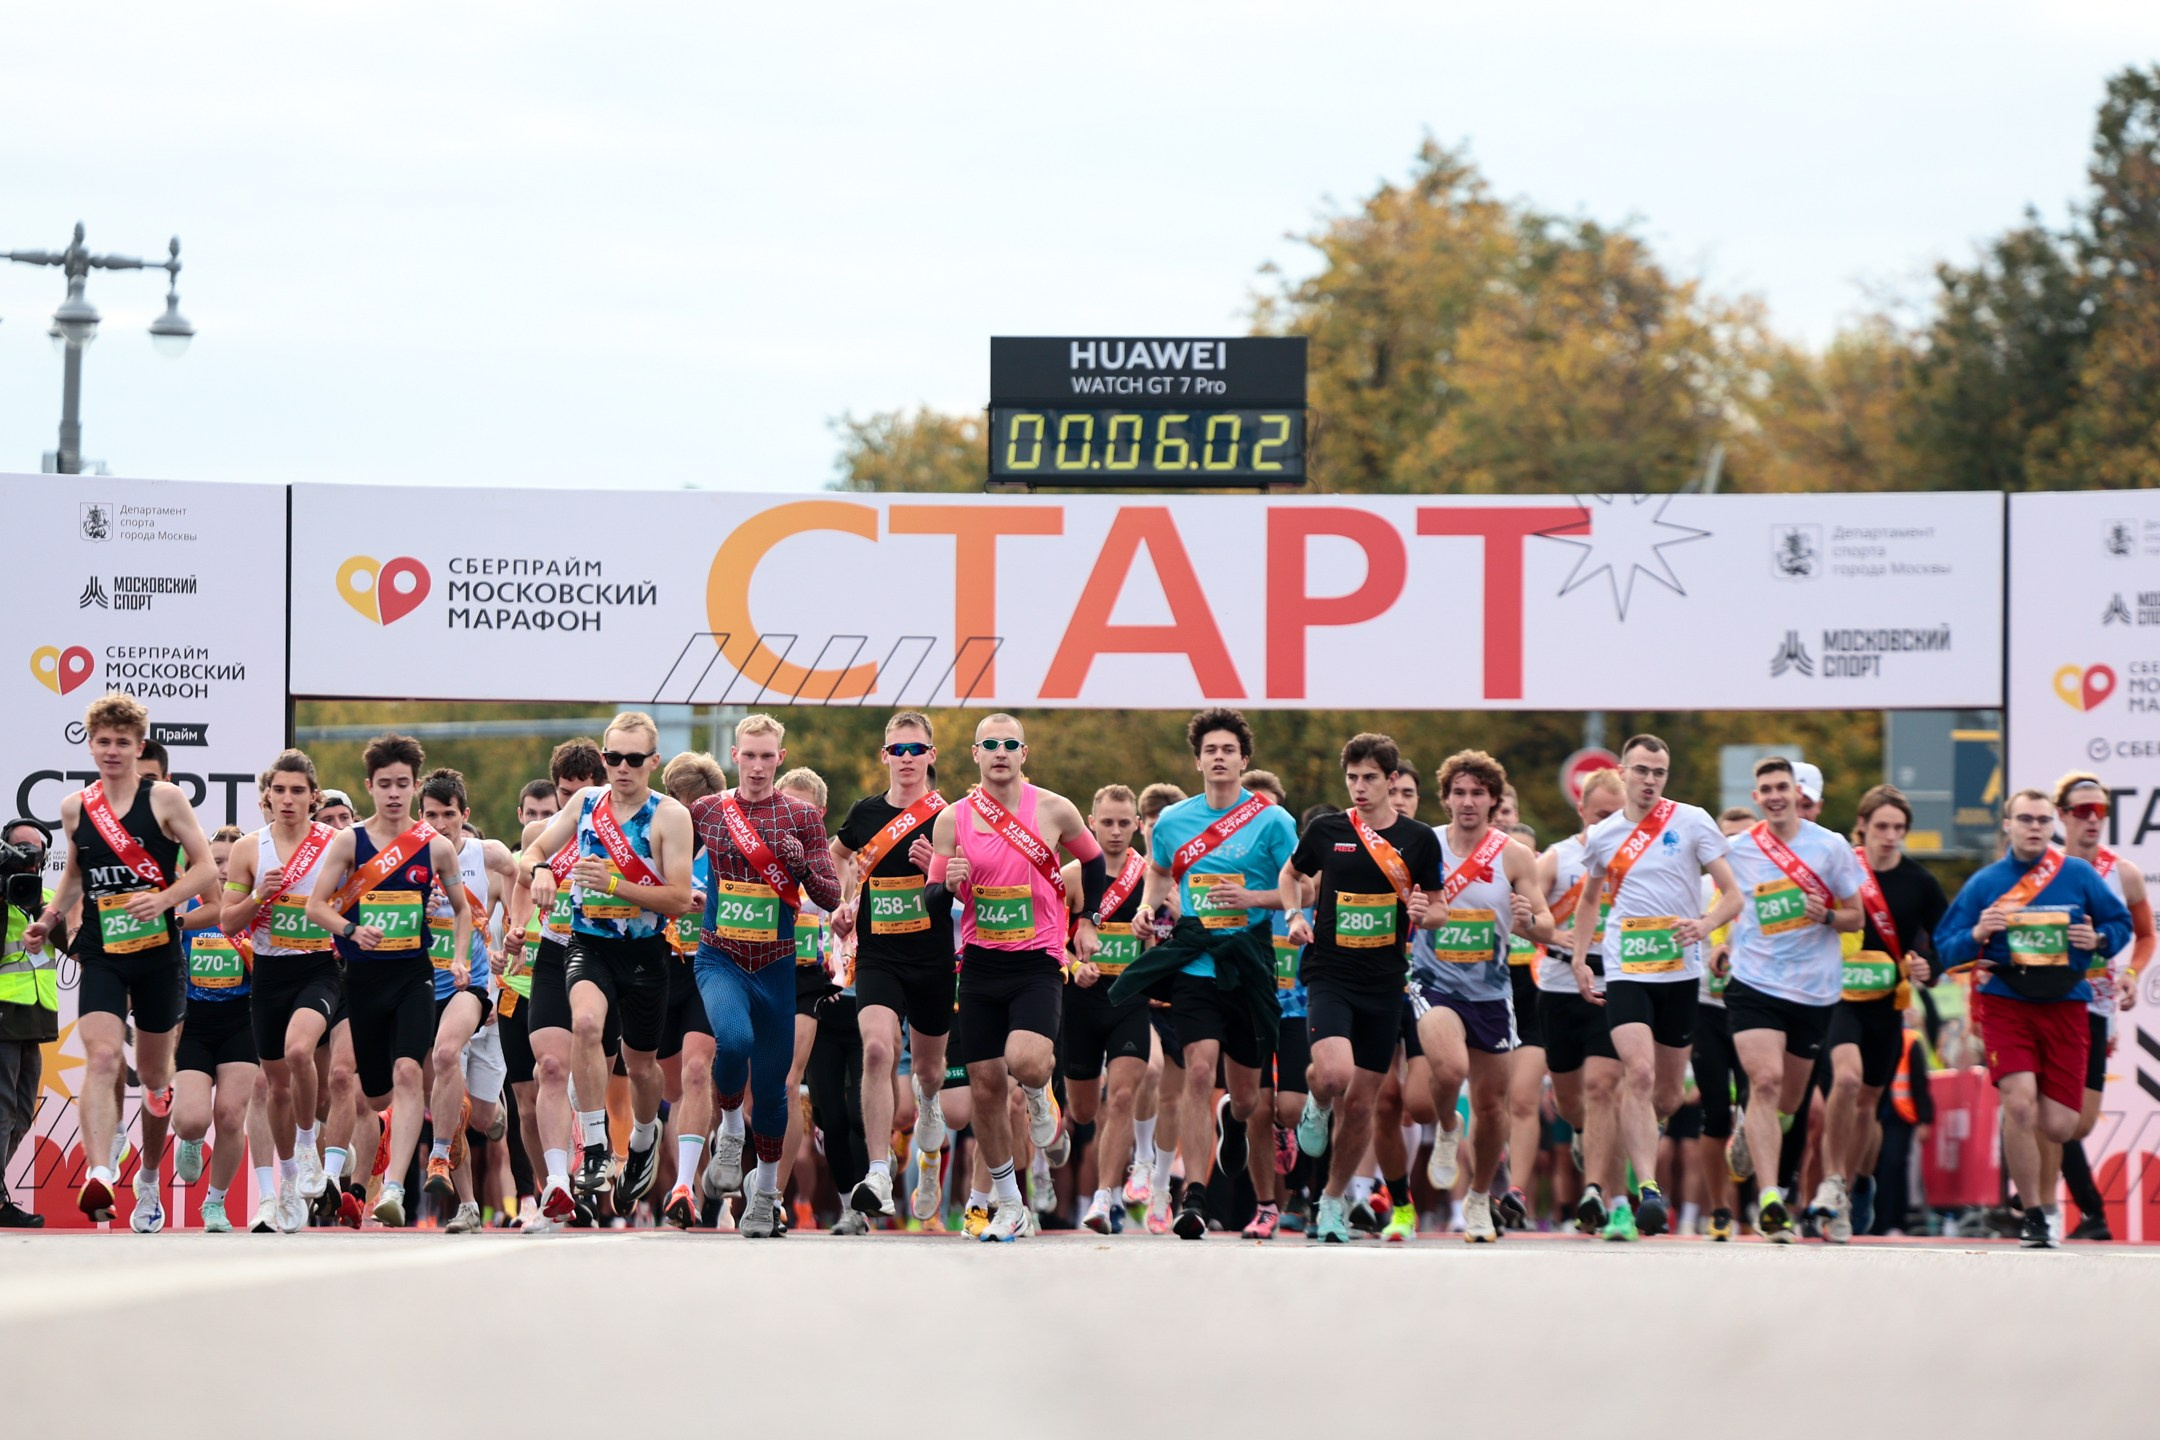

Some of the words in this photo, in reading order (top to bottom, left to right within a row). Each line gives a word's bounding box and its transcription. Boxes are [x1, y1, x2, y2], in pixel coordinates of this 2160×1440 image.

[1070, 341, 1227, 370] HUAWEI
[1071, 377, 1143, 394] WATCH
[1149, 377, 1174, 394] GT
[1180, 377, 1191, 393] 7
[1195, 377, 1227, 394] Pro
[1007, 414, 1291, 471] 00.06.02
[120, 504, 187, 517] Департамент
[120, 520, 155, 529] спорта
[1832, 526, 1935, 540] Департамент
[120, 532, 155, 541] города
[158, 532, 198, 541] Москвы
[1832, 545, 1886, 558] спорта
[449, 557, 601, 577] СБЕРПРАЙМ
[1832, 563, 1886, 577] города
[1890, 562, 1952, 576] Москвы
[114, 575, 198, 595] МОСКОВСКИЙ
[449, 580, 657, 605] МОСКОВСКИЙ
[114, 595, 153, 611] СПОРТ
[706, 500, 1592, 700] СТАРТ
[449, 608, 601, 632] МАРАФОН
[1823, 623, 1952, 651] МОСКОВСКИЙ
[106, 646, 209, 660] СБЕРПРАЙМ
[106, 661, 246, 681] МОСКОВСКИЙ
[1823, 654, 1882, 678] СПОРТ
[106, 683, 208, 699] МАРАФОН
[155, 727, 198, 743] Прайм
[727, 805, 760, 851] ЭСТАФЕТА
[886, 812, 917, 841] 258
[1219, 803, 1264, 837] ЭСТАФЕТА
[601, 813, 633, 863] ЭСТАФЕТА
[723, 809, 752, 854] СТУДЕНЧЕСКА
[1008, 821, 1049, 862] ЭСТАФЕТА
[1180, 838, 1206, 864] 245
[1623, 830, 1651, 860] 284
[375, 845, 404, 874] 267
[763, 863, 789, 891] 296
[720, 901, 773, 922] 296-1
[873, 894, 923, 915] 258-1
[977, 904, 1028, 923] 244-1
[274, 912, 326, 932] 261-
[363, 911, 418, 931] 267-1
[1339, 911, 1392, 930] 280-1
[1438, 925, 1490, 944] 274-1
[2012, 930, 2064, 948] 242-1
[1624, 938, 1678, 956] 284-1
[192, 955, 241, 971] 270-1
[1842, 967, 1892, 985] 278-1
